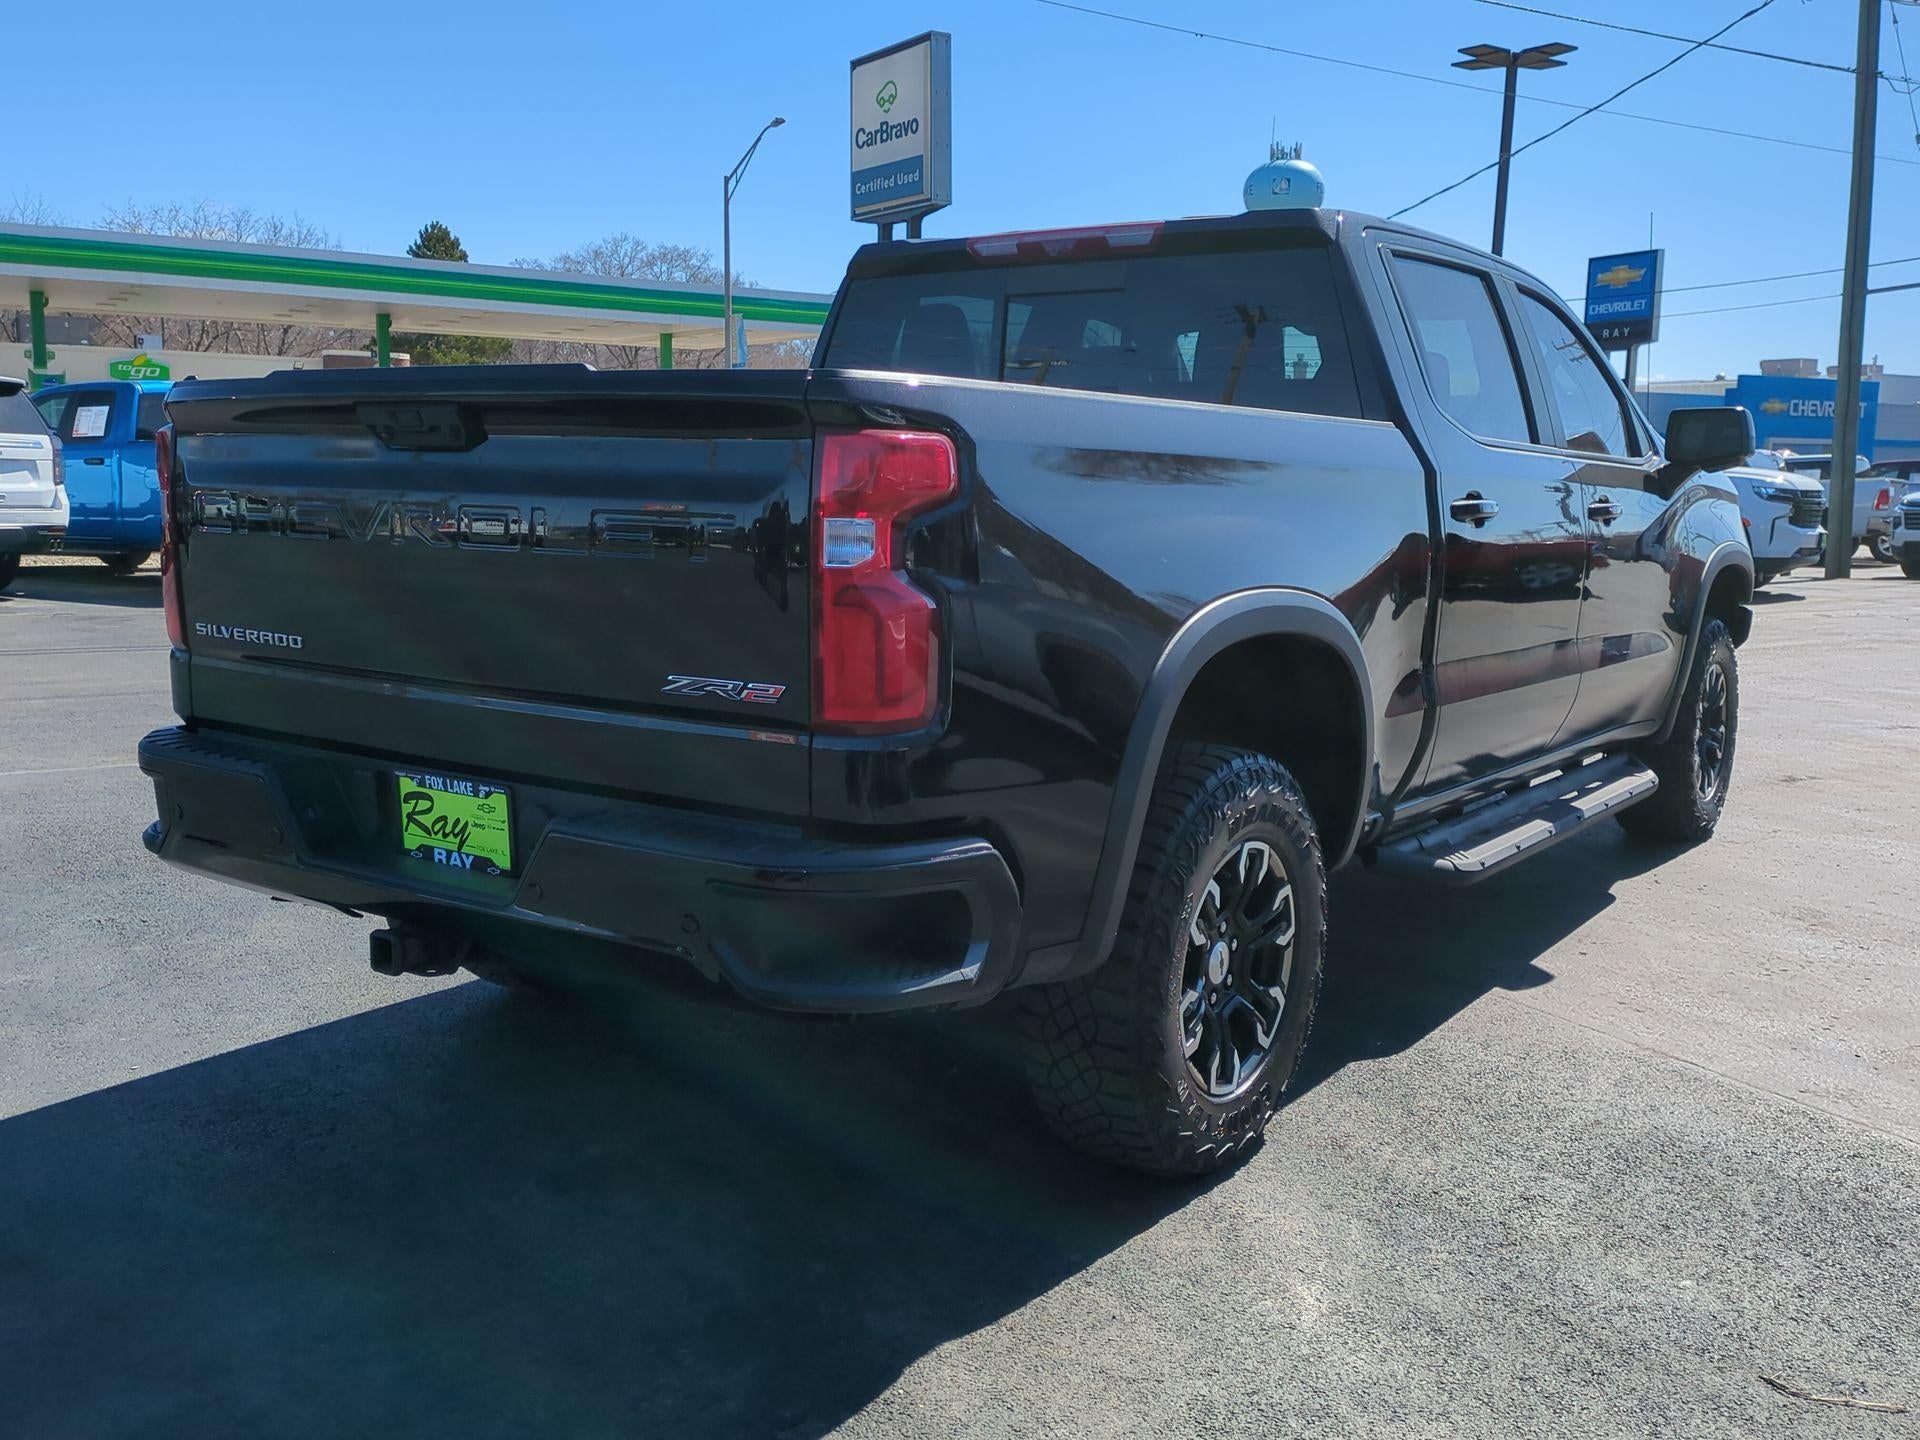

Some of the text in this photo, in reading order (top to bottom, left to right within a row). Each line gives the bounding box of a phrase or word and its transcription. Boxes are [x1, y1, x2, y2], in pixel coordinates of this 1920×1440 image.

[855, 117, 919, 149] CarBravo
[855, 169, 920, 195] Certified Used
[1589, 299, 1647, 315] CHEVROLET
[1602, 327, 1630, 338] RAY
[129, 366, 161, 379] go
[1789, 399, 1867, 418] CHEVRT
[193, 490, 737, 563] CHEVROLET
[195, 622, 304, 649] SILVERADO
[660, 675, 787, 704] ZR2
[424, 775, 474, 796] FOX LAKE
[402, 791, 472, 852] Ray
[471, 820, 486, 831] Jeep
[433, 847, 474, 870] RAY
